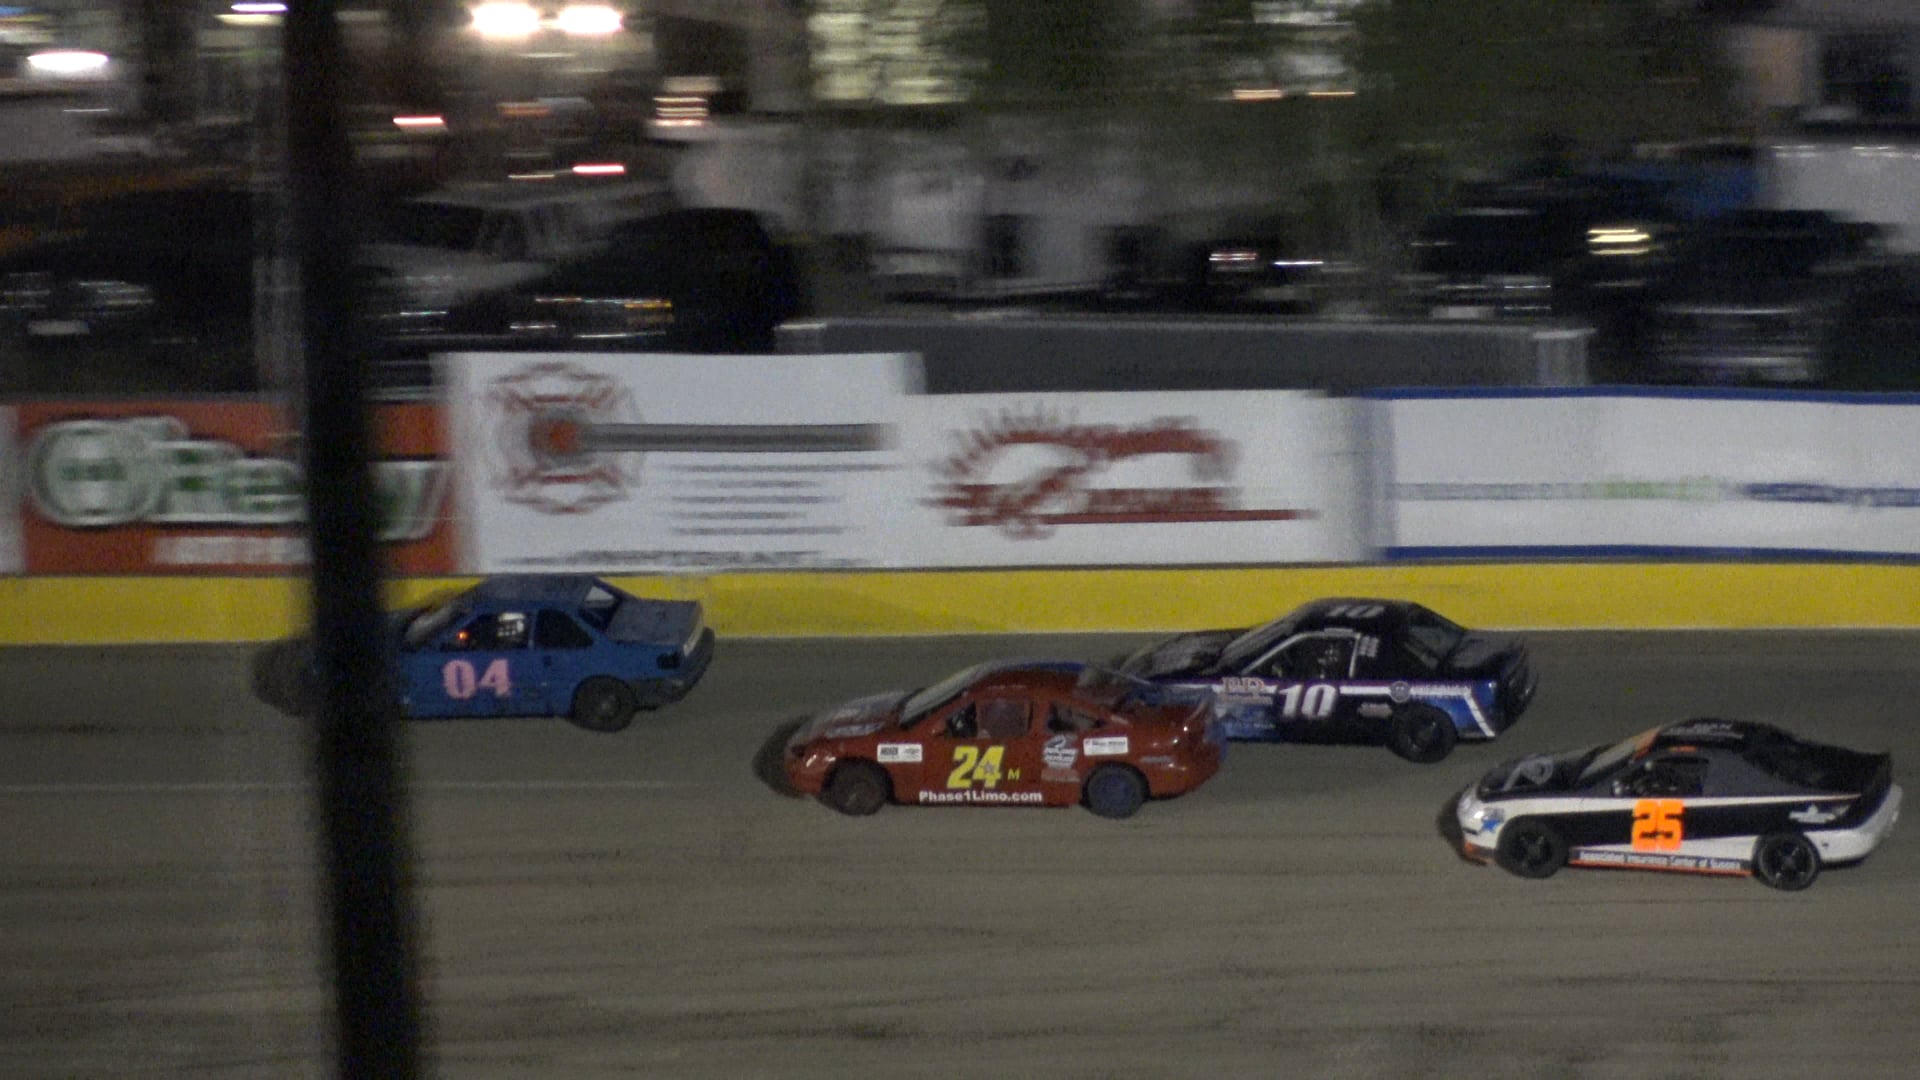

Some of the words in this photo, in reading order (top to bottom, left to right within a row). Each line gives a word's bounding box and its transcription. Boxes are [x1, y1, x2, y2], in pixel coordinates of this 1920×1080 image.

[442, 658, 512, 700] 04
[1279, 684, 1337, 717] 10
[947, 745, 1004, 789] 24
[1008, 768, 1020, 781] M
[919, 790, 1043, 803] Phase1Limo.com
[1632, 798, 1683, 852] 25
